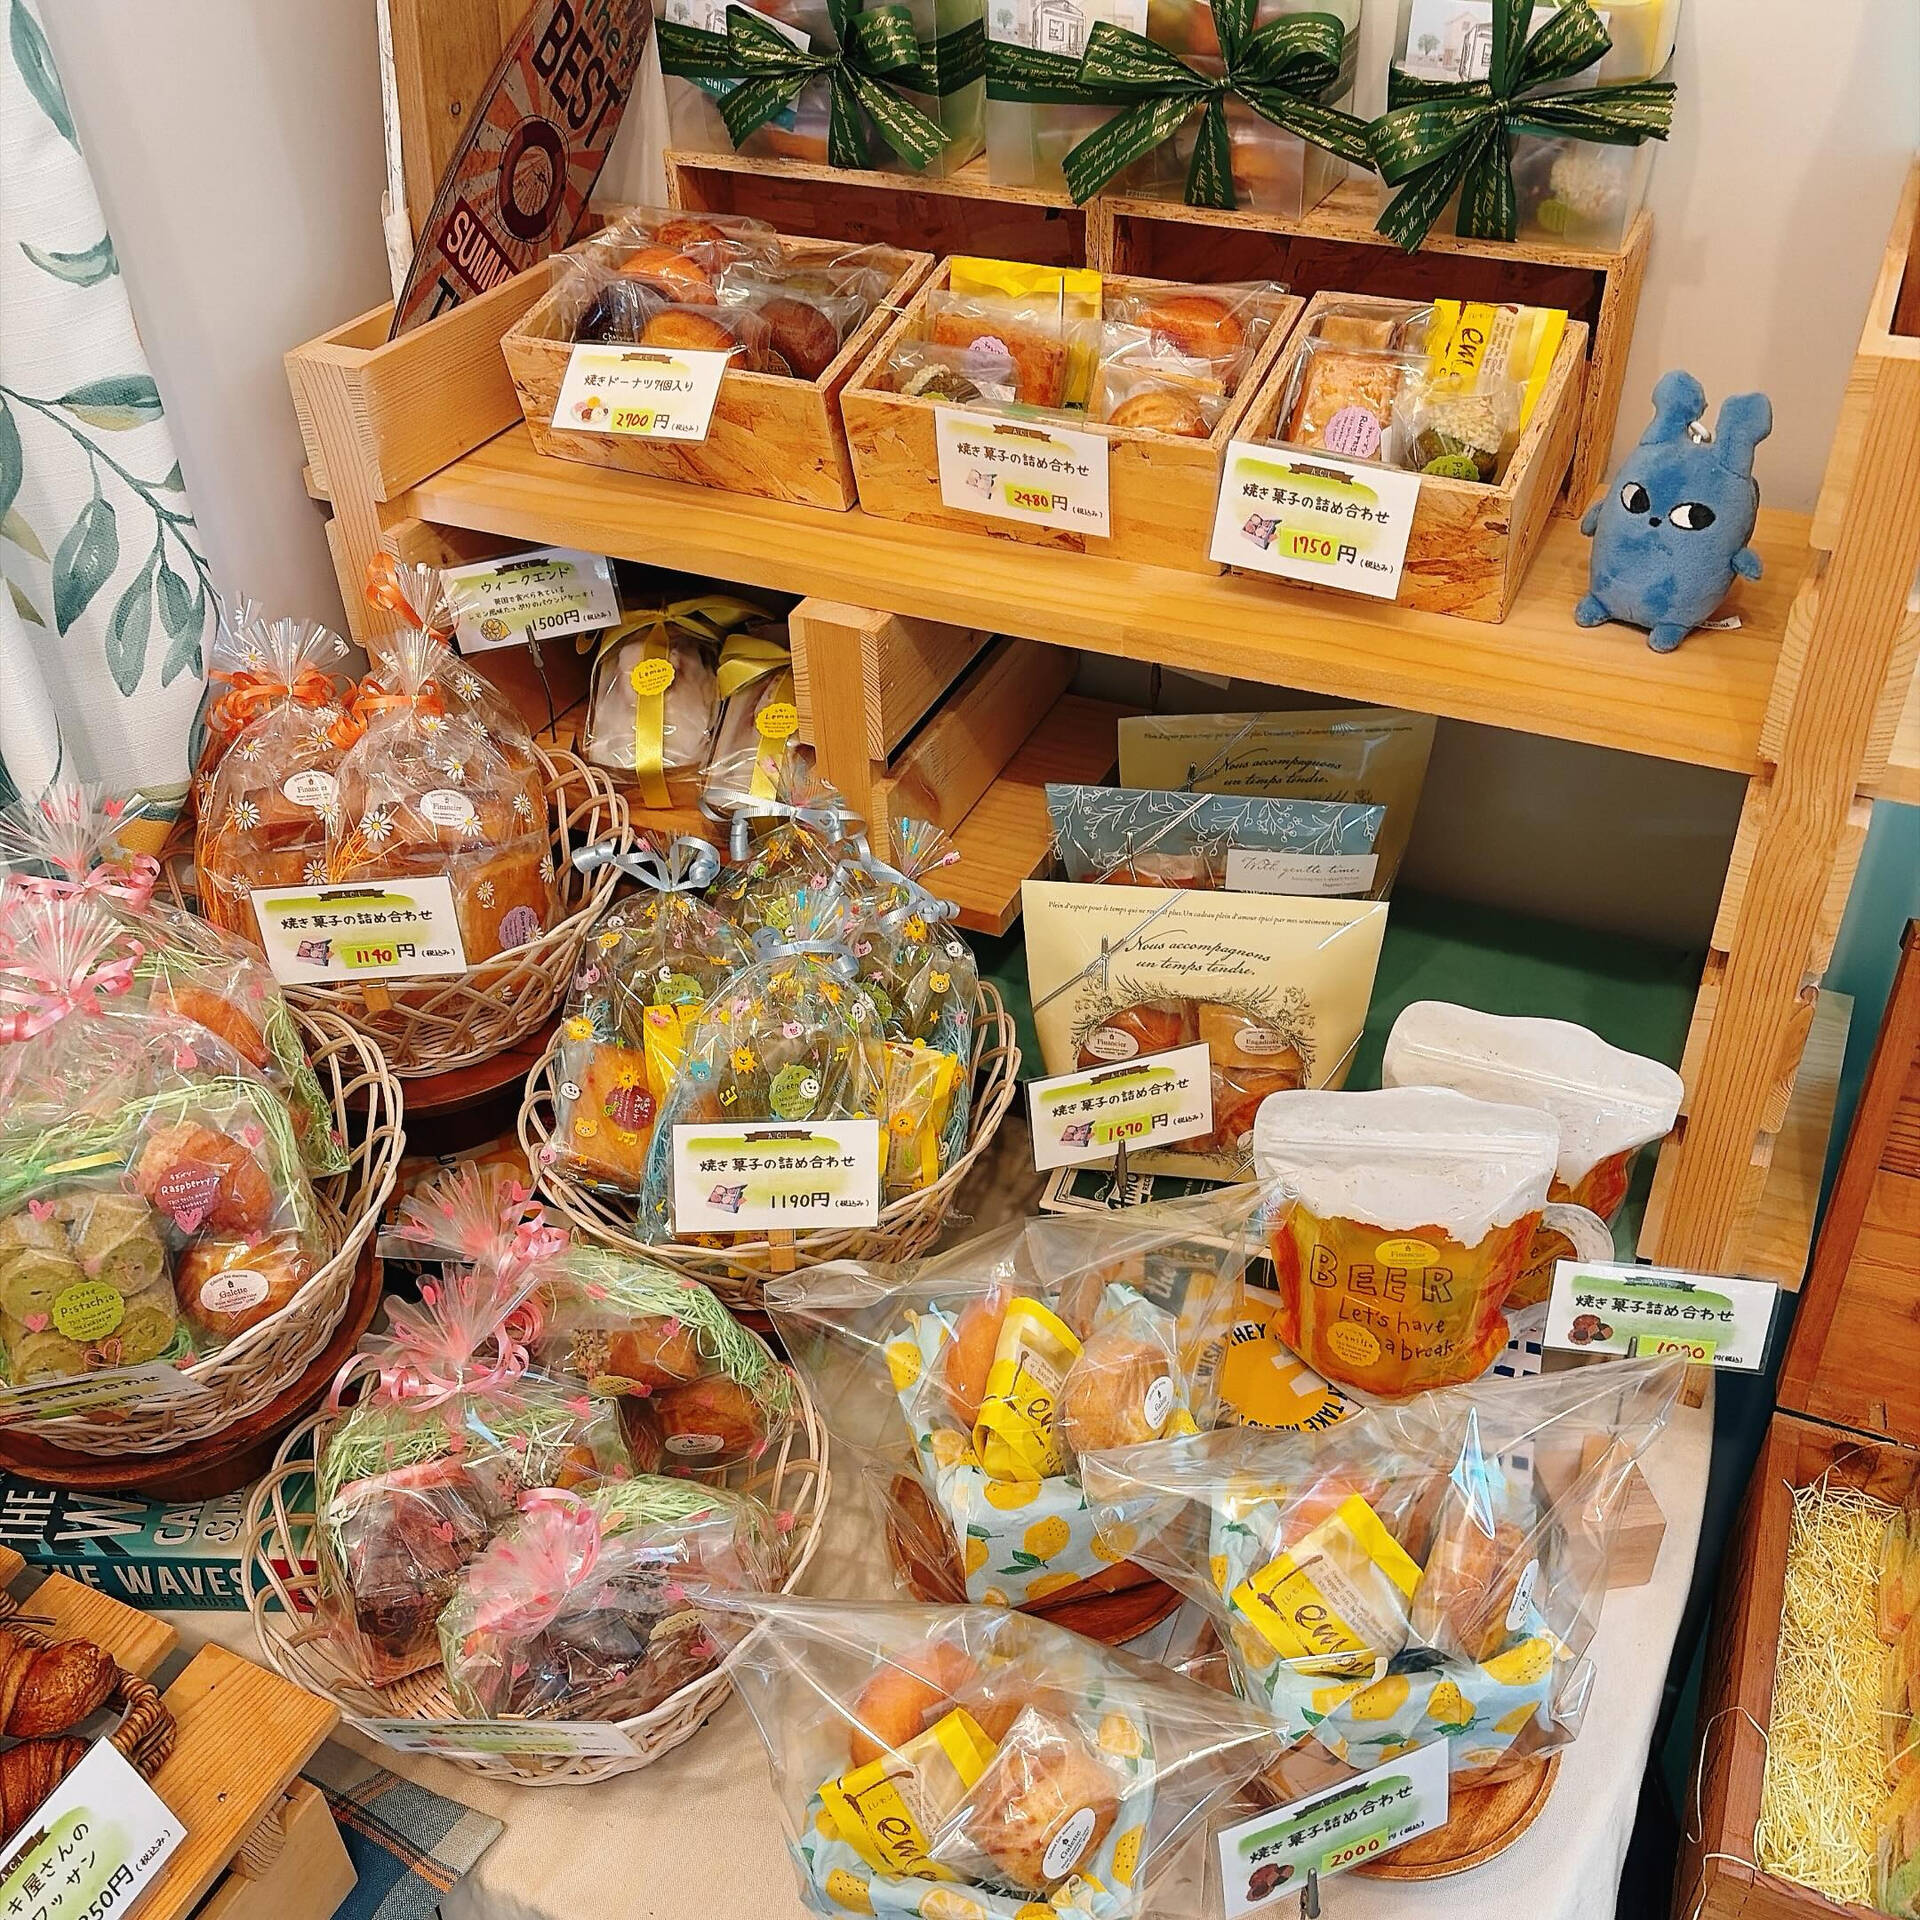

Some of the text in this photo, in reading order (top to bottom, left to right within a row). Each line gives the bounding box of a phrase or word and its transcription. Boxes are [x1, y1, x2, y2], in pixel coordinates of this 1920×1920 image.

[531, 0, 621, 148] BEST
[957, 442, 1090, 477] 焼き菓子の詰め合わせ
[1242, 482, 1391, 525] 焼き菓子の詰め合わせ
[481, 567, 570, 593] ウィークエンド
[638, 666, 668, 679] Lemon
[281, 909, 433, 930] 焼き菓子の詰め合わせ
[1169, 940, 1271, 962] accompagnons
[1136, 960, 1158, 968] un
[1160, 956, 1203, 975] temps
[1052, 1078, 1190, 1118] 焼き菓子の詰め合わせ
[700, 1154, 856, 1173] 焼き菓子の詰め合わせ
[161, 1177, 218, 1196] Raspberry
[771, 1192, 830, 1208] 1190円
[1310, 1243, 1453, 1304] BEER
[60, 1293, 115, 1318] Pistachio
[218, 1286, 248, 1300] Galette
[1339, 1296, 1445, 1336] Let's have
[1575, 1294, 1735, 1323] 焼き菓子詰め合わせ
[113, 1564, 255, 1597] WAVES
[1249, 1784, 1414, 1864] 焼き菓子詰め合わせ
[1060, 1830, 1082, 1860] Galette
